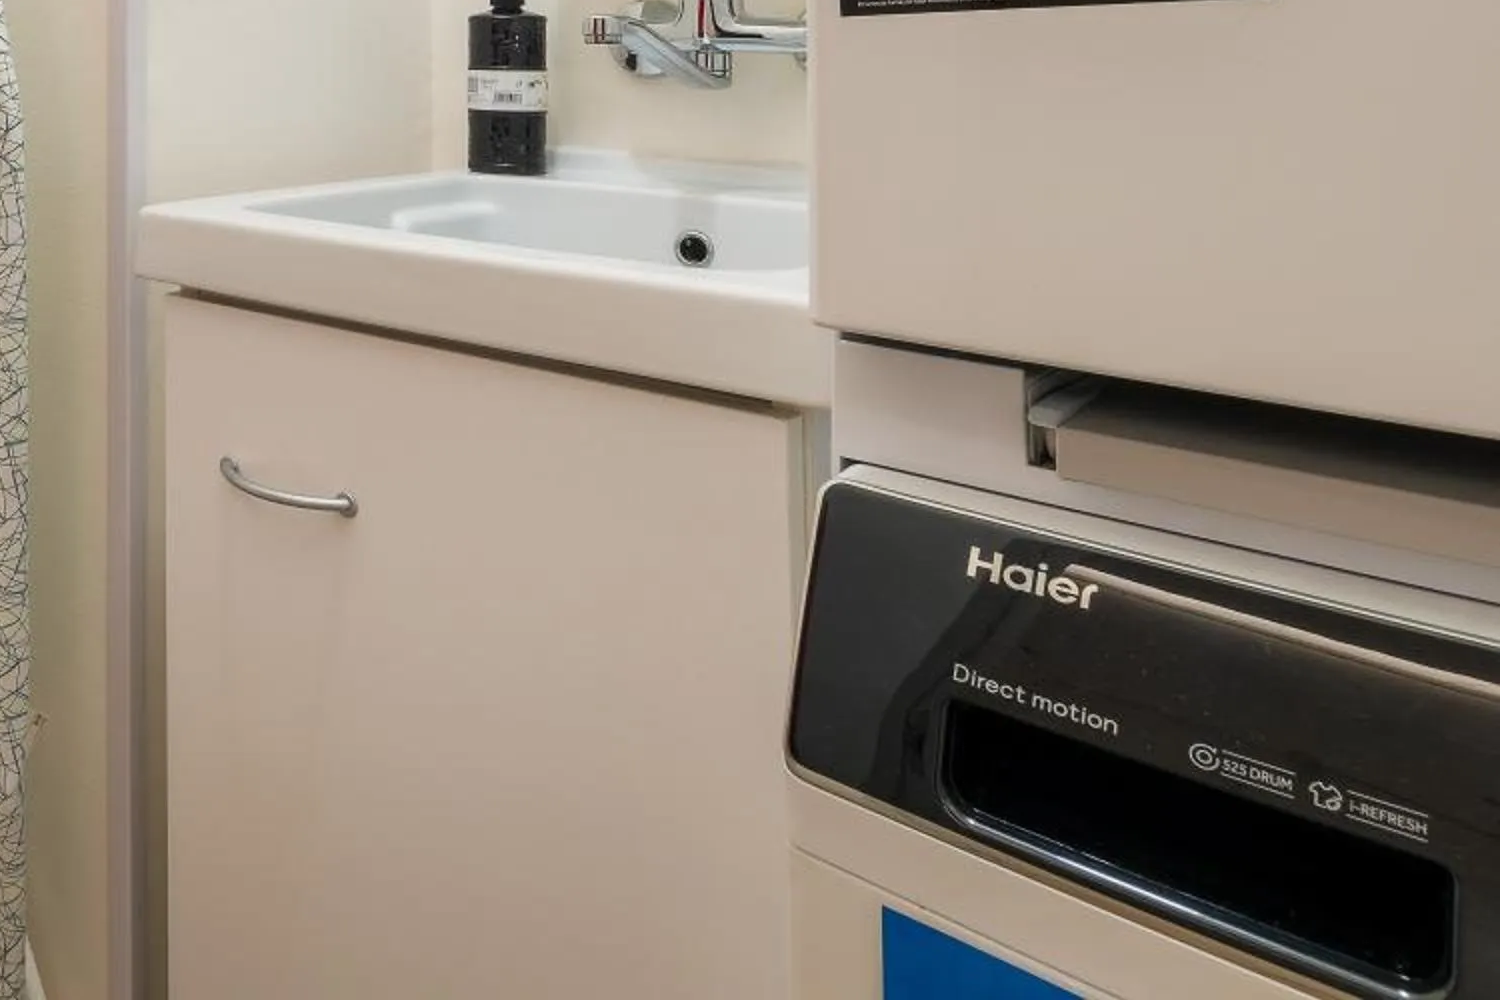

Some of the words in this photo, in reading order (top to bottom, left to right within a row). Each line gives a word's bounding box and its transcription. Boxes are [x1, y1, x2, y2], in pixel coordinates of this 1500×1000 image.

[966, 545, 1099, 610] Haier
[952, 662, 1025, 704] Direct
[1031, 692, 1118, 736] motion
[1222, 759, 1247, 776] 525
[1249, 767, 1293, 791] DRUM
